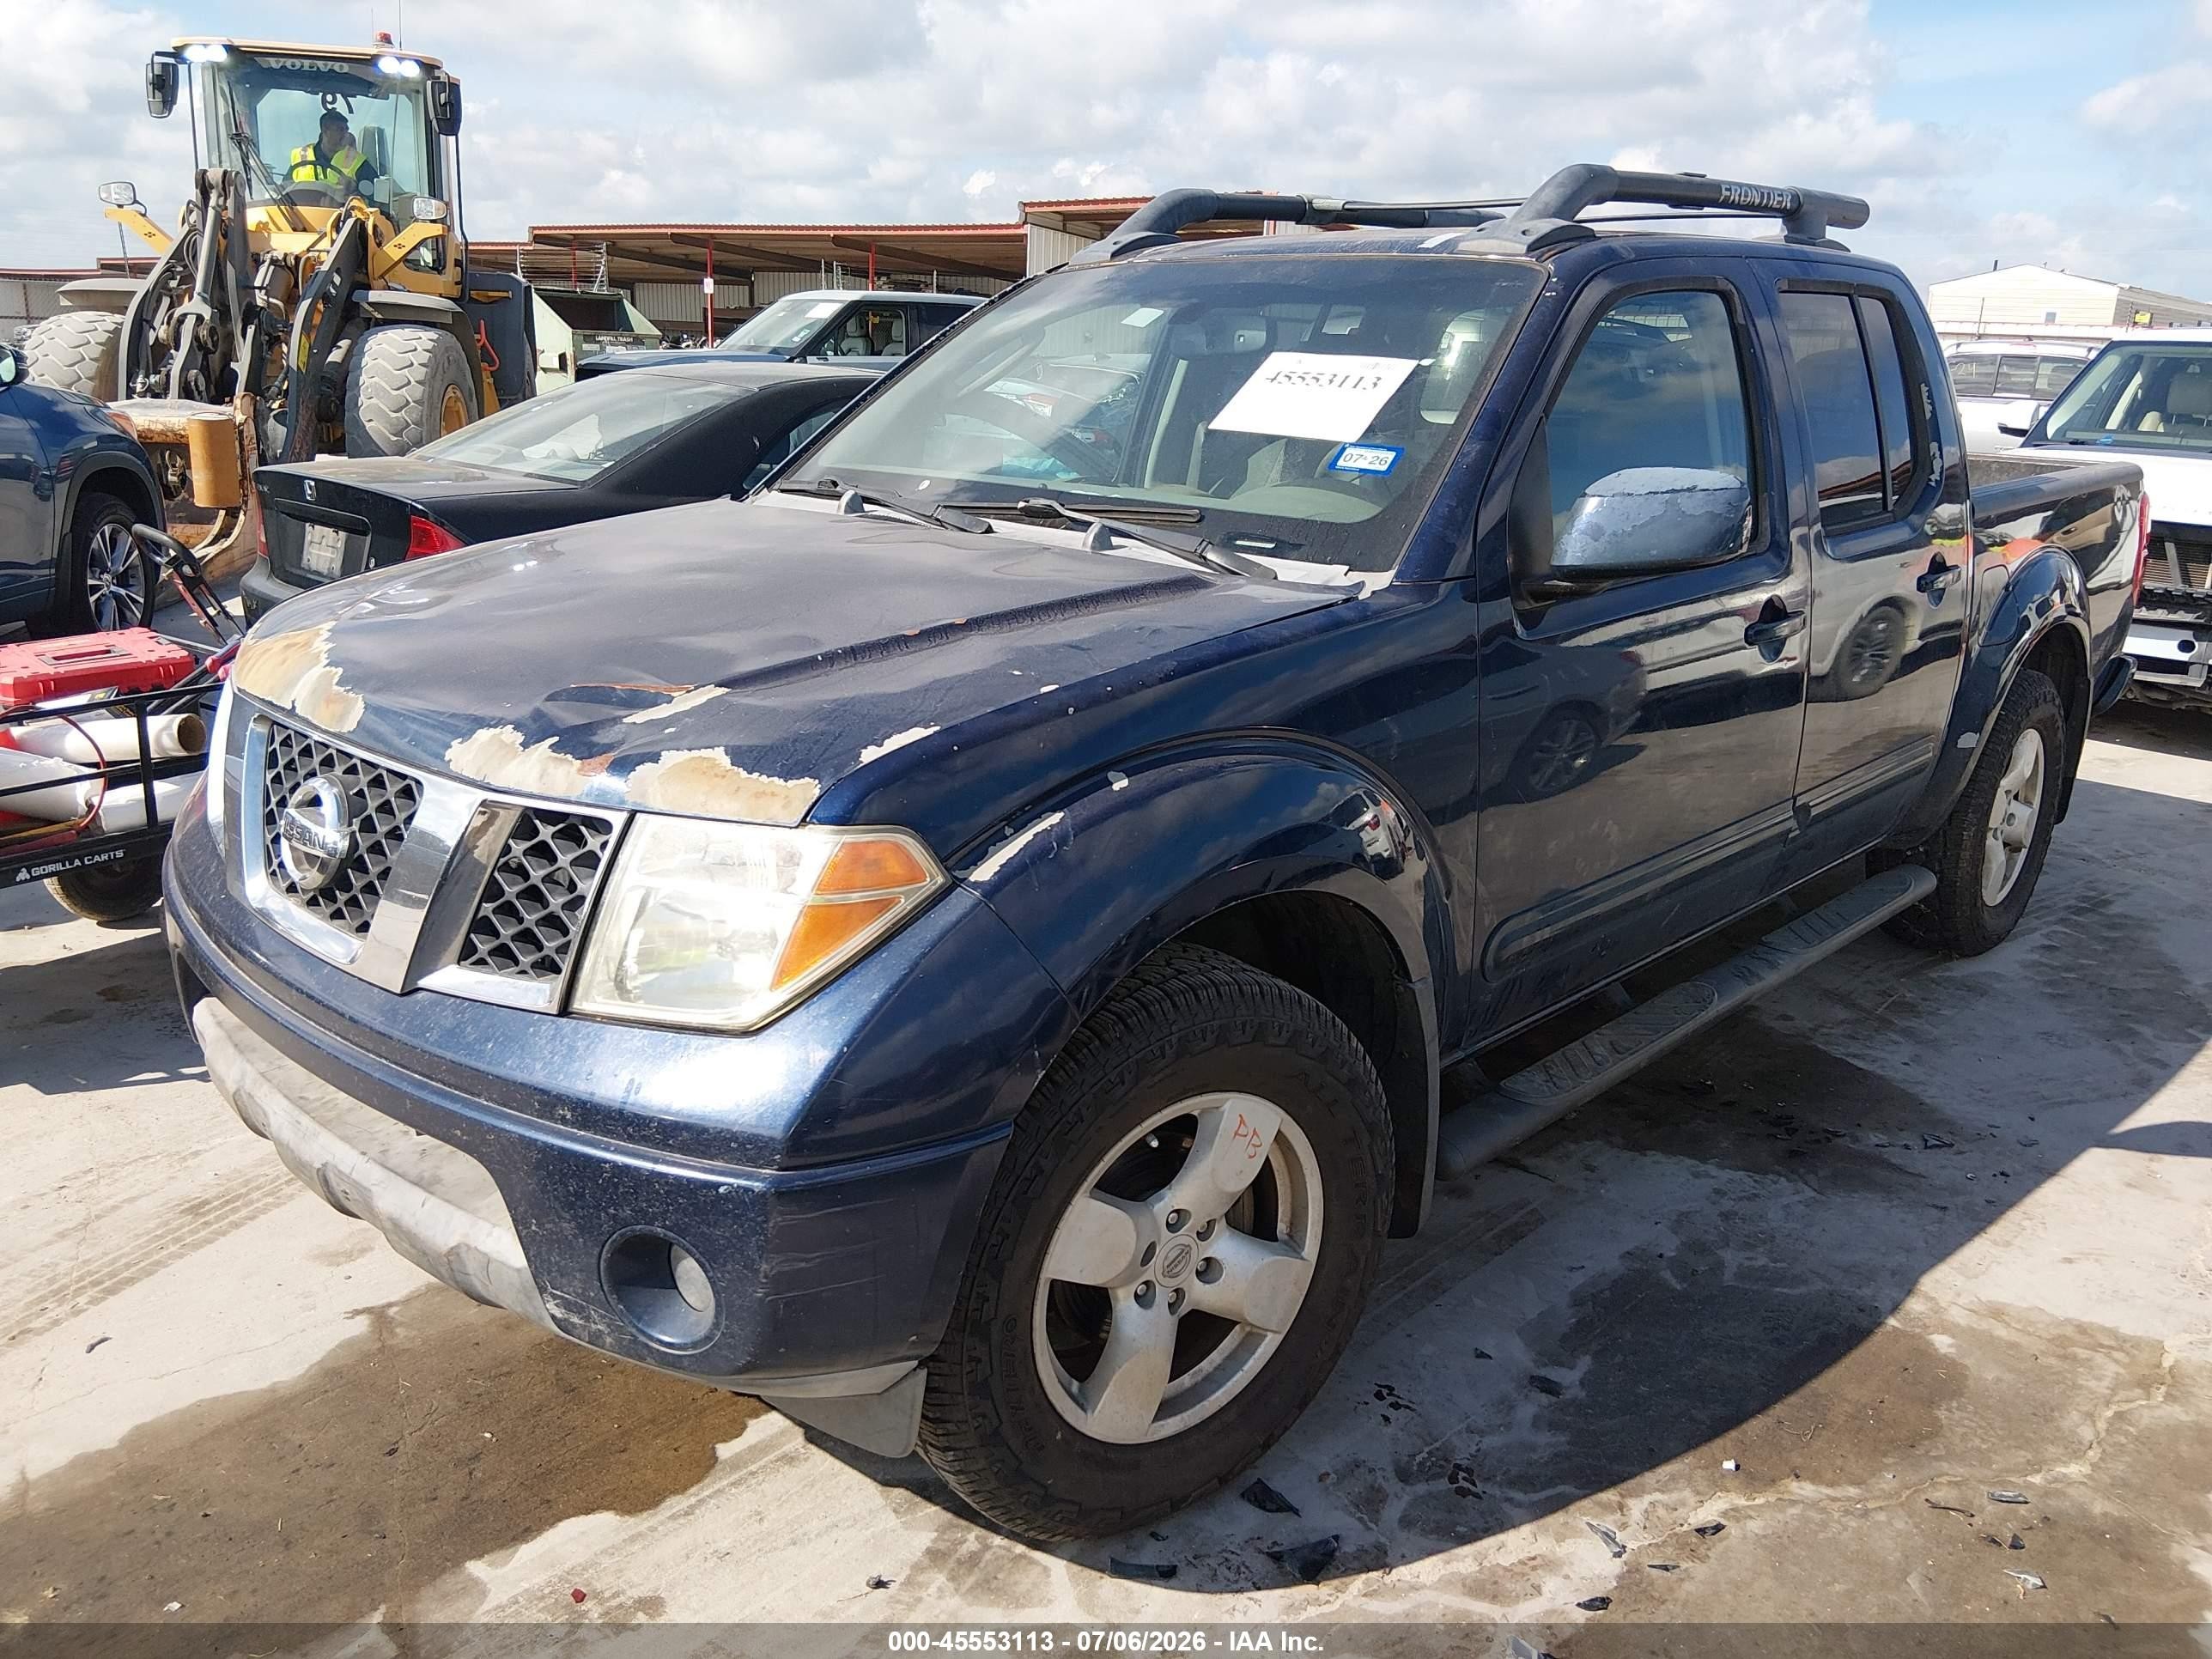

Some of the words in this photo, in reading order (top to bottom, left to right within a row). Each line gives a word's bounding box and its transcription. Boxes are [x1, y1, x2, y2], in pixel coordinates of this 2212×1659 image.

[268, 58, 349, 73] VOLVO
[1718, 184, 1792, 210] FRONTIER
[1266, 371, 1382, 391] 45553113
[1343, 453, 1364, 464] 07
[1368, 455, 1389, 466] 26
[31, 858, 82, 877] GORILLA
[84, 849, 125, 865] CARTS
[1232, 1113, 1263, 1159] PB
